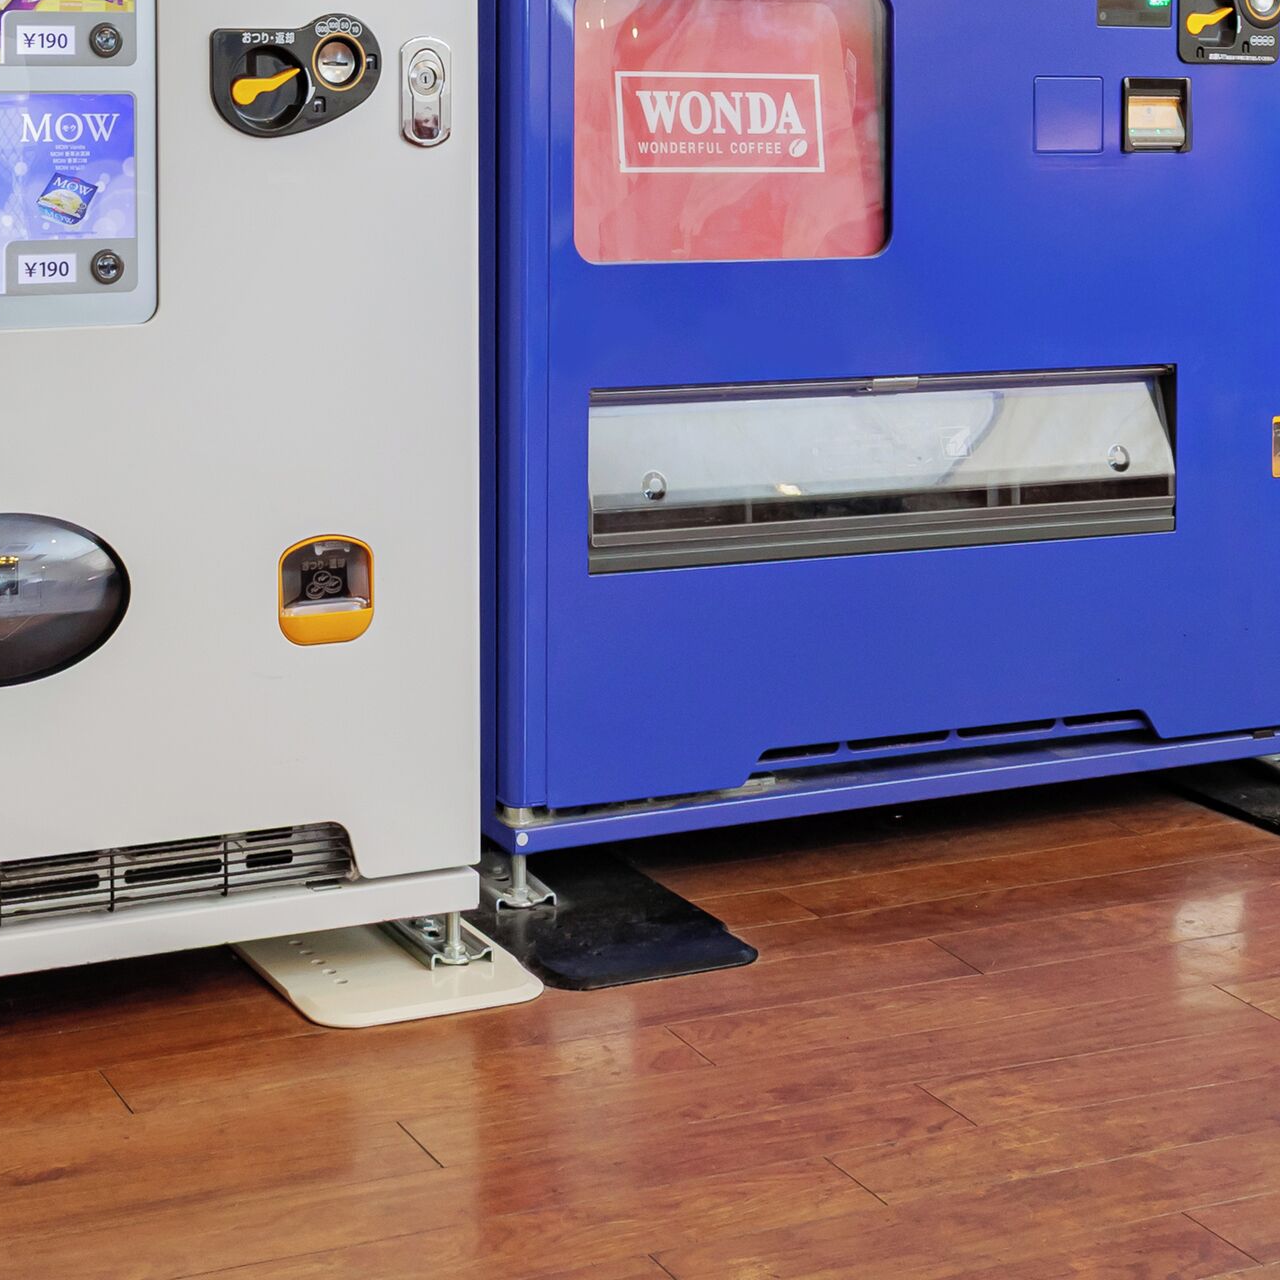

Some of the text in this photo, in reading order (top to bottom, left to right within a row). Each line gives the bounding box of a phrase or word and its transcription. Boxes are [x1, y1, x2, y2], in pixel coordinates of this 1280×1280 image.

[24, 32, 68, 49] ¥190
[242, 32, 295, 44] おつり・返却
[636, 91, 806, 135] WONDA
[20, 113, 120, 143] MOW
[638, 142, 782, 154] WONDERFUL COFFEE
[52, 177, 92, 197] MOW
[24, 262, 70, 277] ¥190
